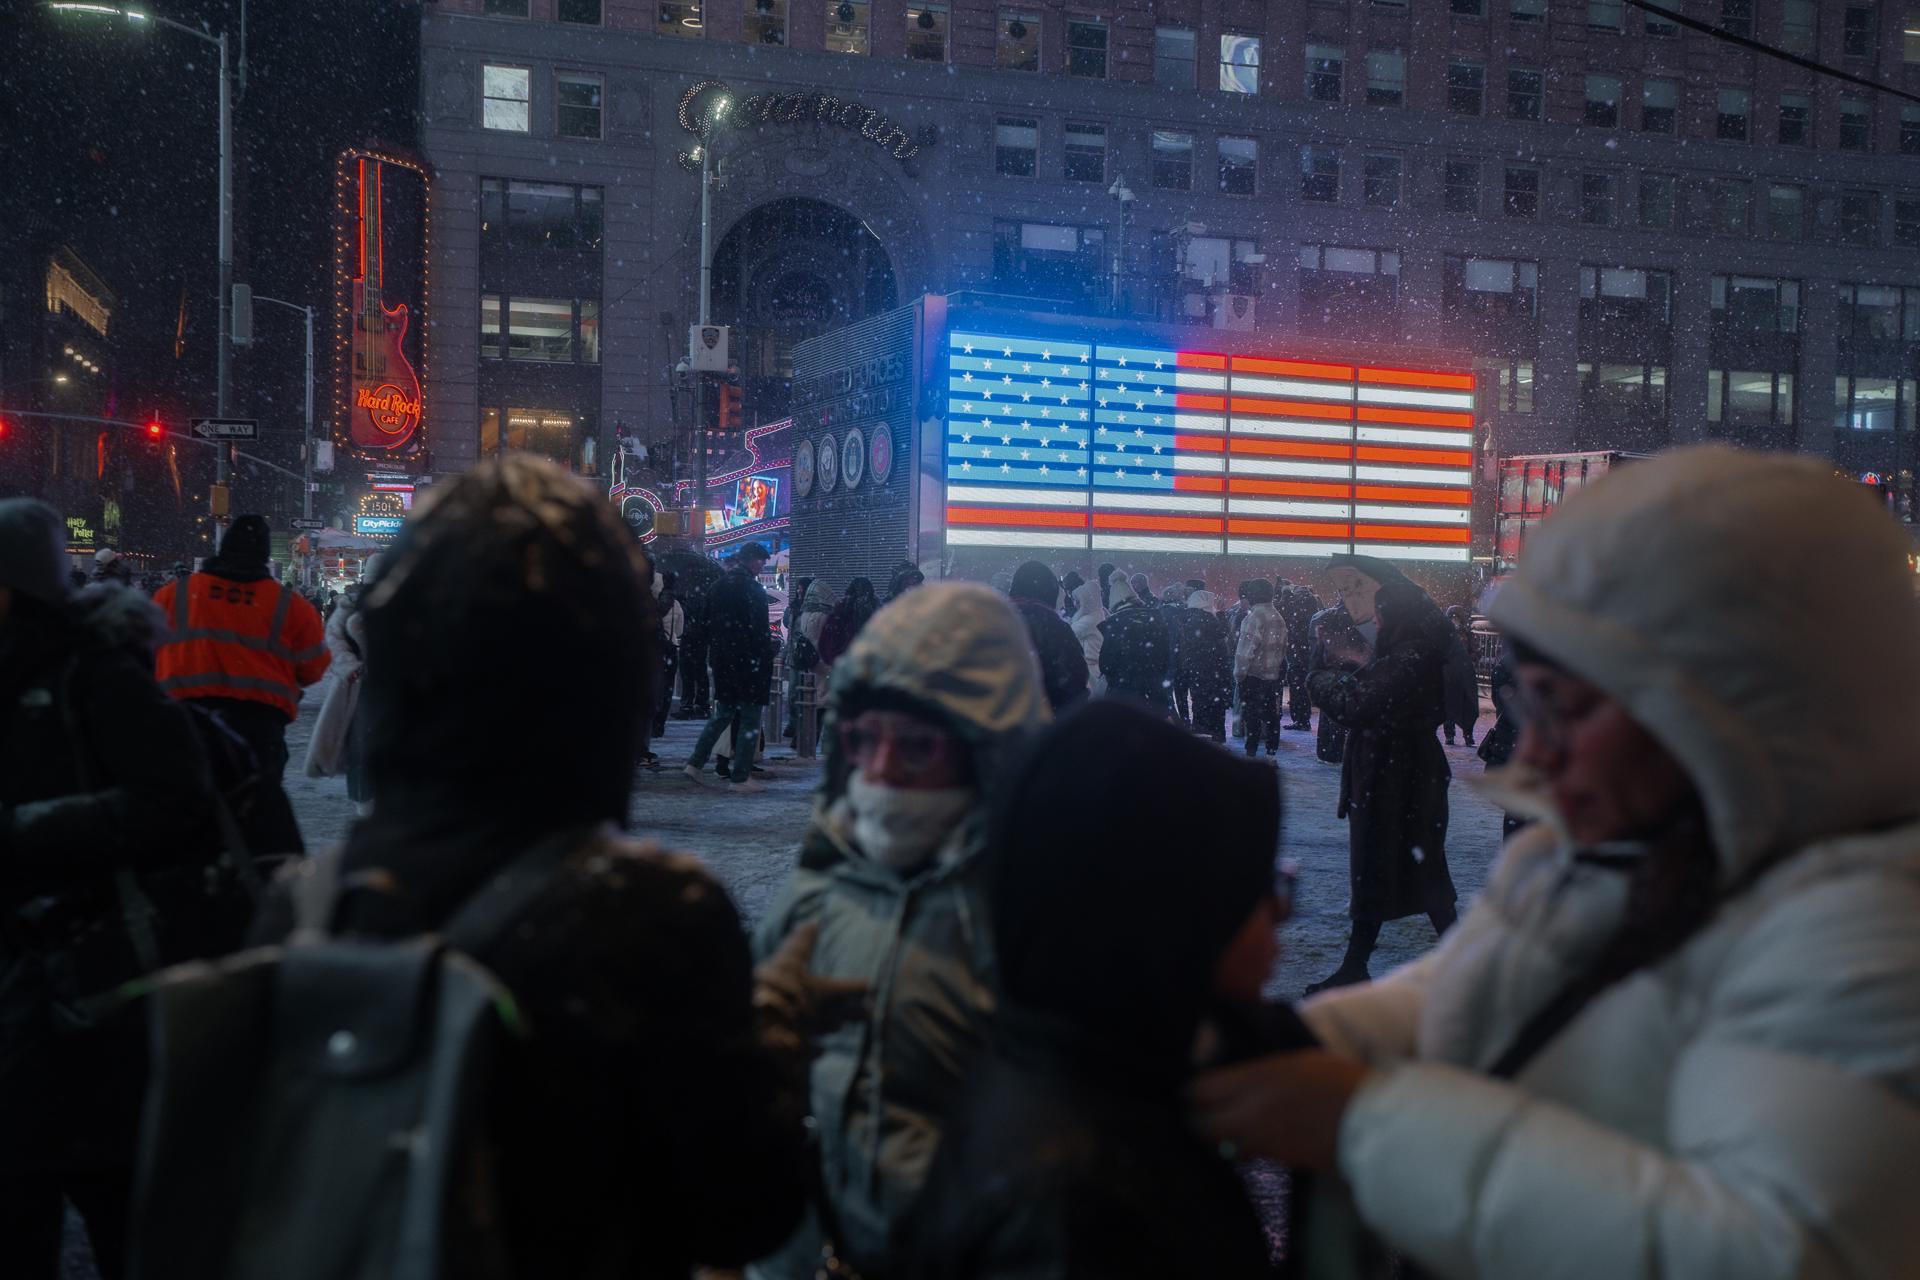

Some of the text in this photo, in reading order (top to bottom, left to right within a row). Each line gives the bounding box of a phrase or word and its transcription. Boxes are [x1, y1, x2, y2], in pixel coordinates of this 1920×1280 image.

[358, 388, 420, 419] Hard Rock
[381, 415, 399, 424] CAFE
[201, 424, 249, 434] ONE WAY
[372, 502, 391, 511] 1501
[66, 516, 87, 528] Harry
[73, 527, 94, 540] Potter
